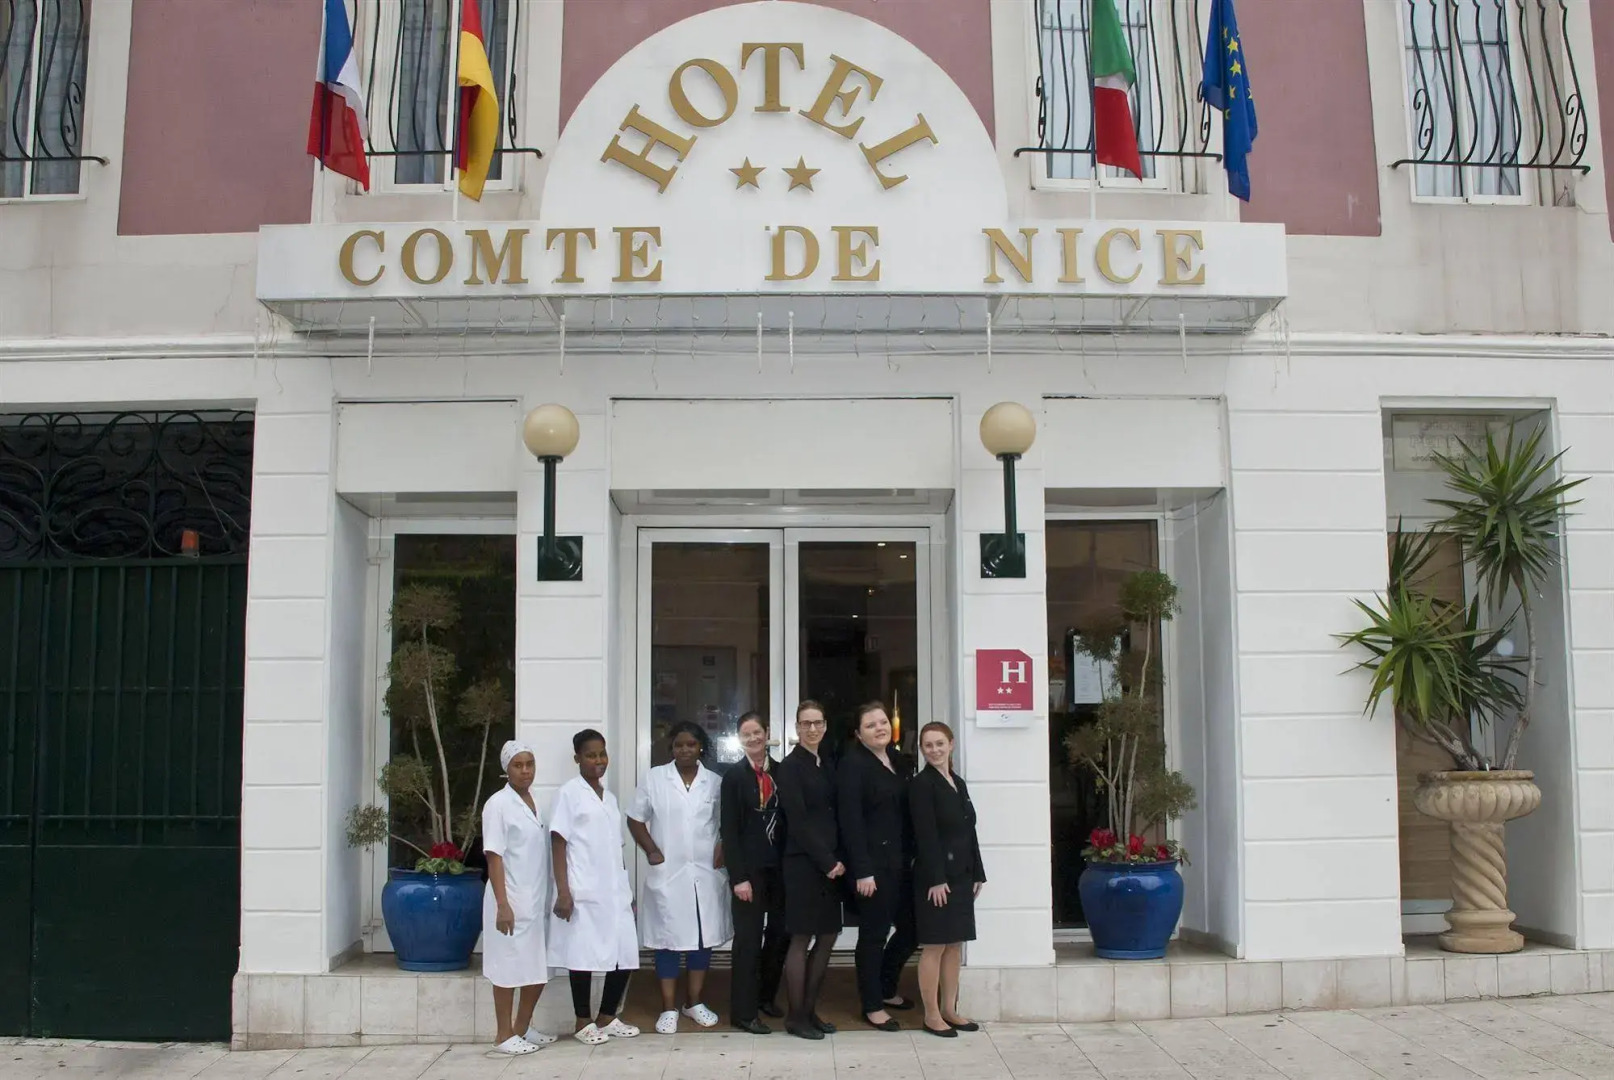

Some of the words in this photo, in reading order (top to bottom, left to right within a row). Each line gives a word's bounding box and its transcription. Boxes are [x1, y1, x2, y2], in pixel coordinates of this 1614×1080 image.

[602, 43, 938, 195] HOTEL
[340, 227, 661, 285] COMTE
[764, 226, 880, 281] DE
[983, 228, 1204, 286] NICE
[1000, 660, 1027, 684] H
